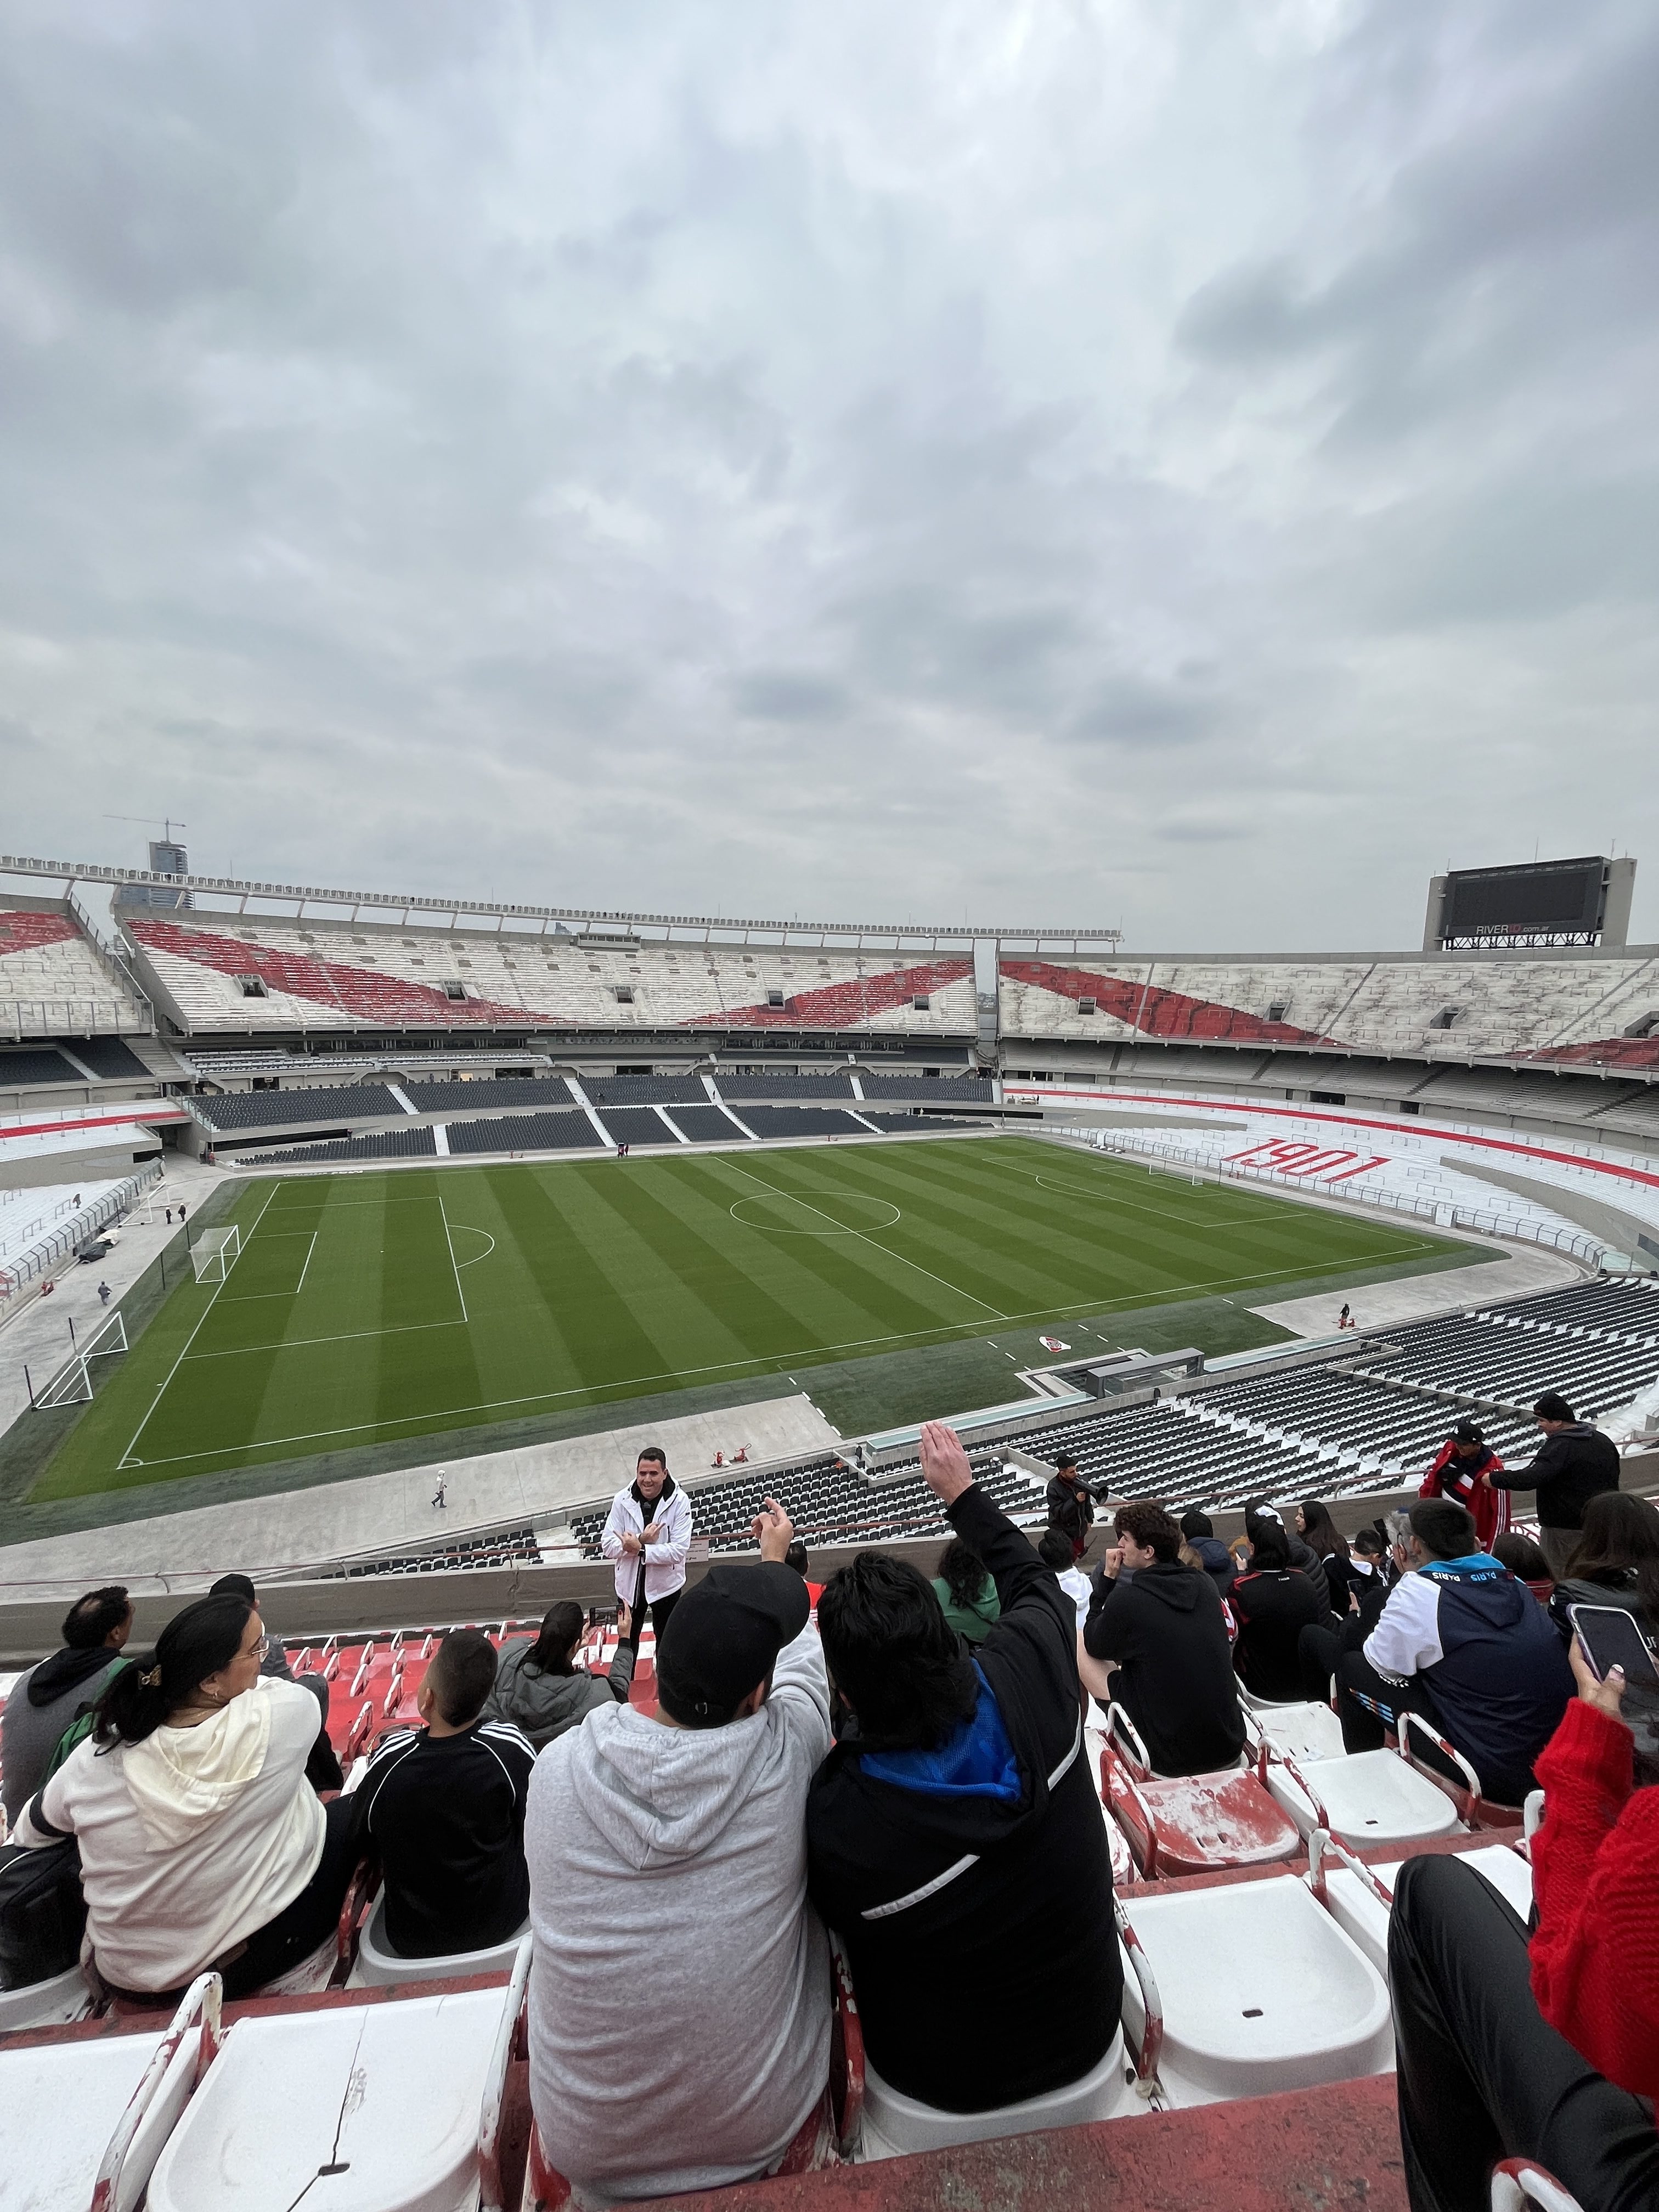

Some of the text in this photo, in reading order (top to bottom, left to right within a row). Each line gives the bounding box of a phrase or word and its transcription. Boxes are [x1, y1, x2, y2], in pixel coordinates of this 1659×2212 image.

[1476, 924, 1509, 934] RIVER
[1221, 1138, 1392, 1183] 1901
[1432, 1571, 1497, 1582] PARIS PARIS
